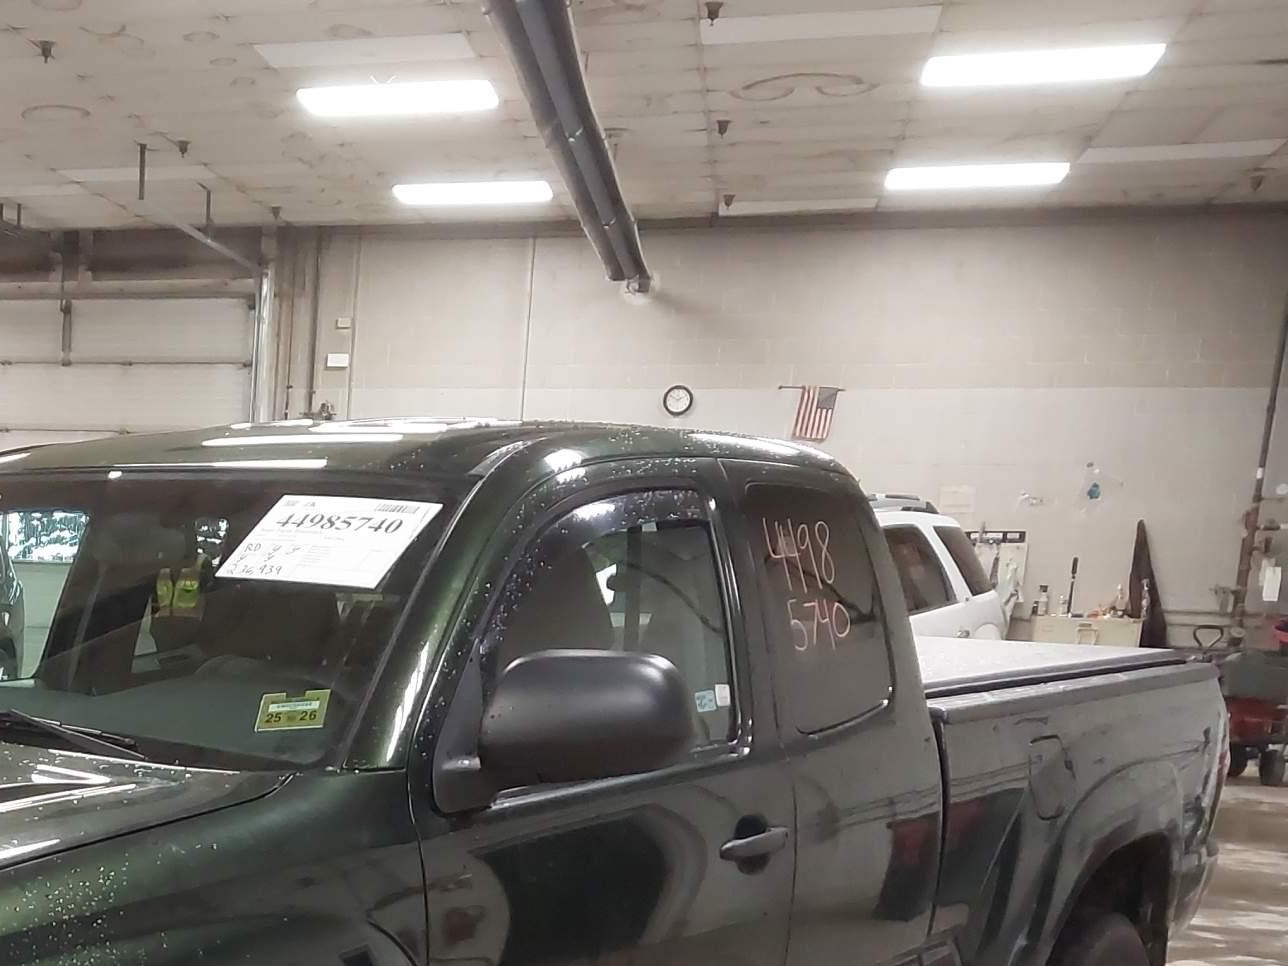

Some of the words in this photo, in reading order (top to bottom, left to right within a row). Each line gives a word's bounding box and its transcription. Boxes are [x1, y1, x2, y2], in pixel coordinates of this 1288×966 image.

[276, 512, 404, 534] 44985740
[762, 516, 835, 593] 4498
[786, 598, 851, 651] 5740
[264, 712, 282, 724] 25
[299, 710, 317, 721] 26
